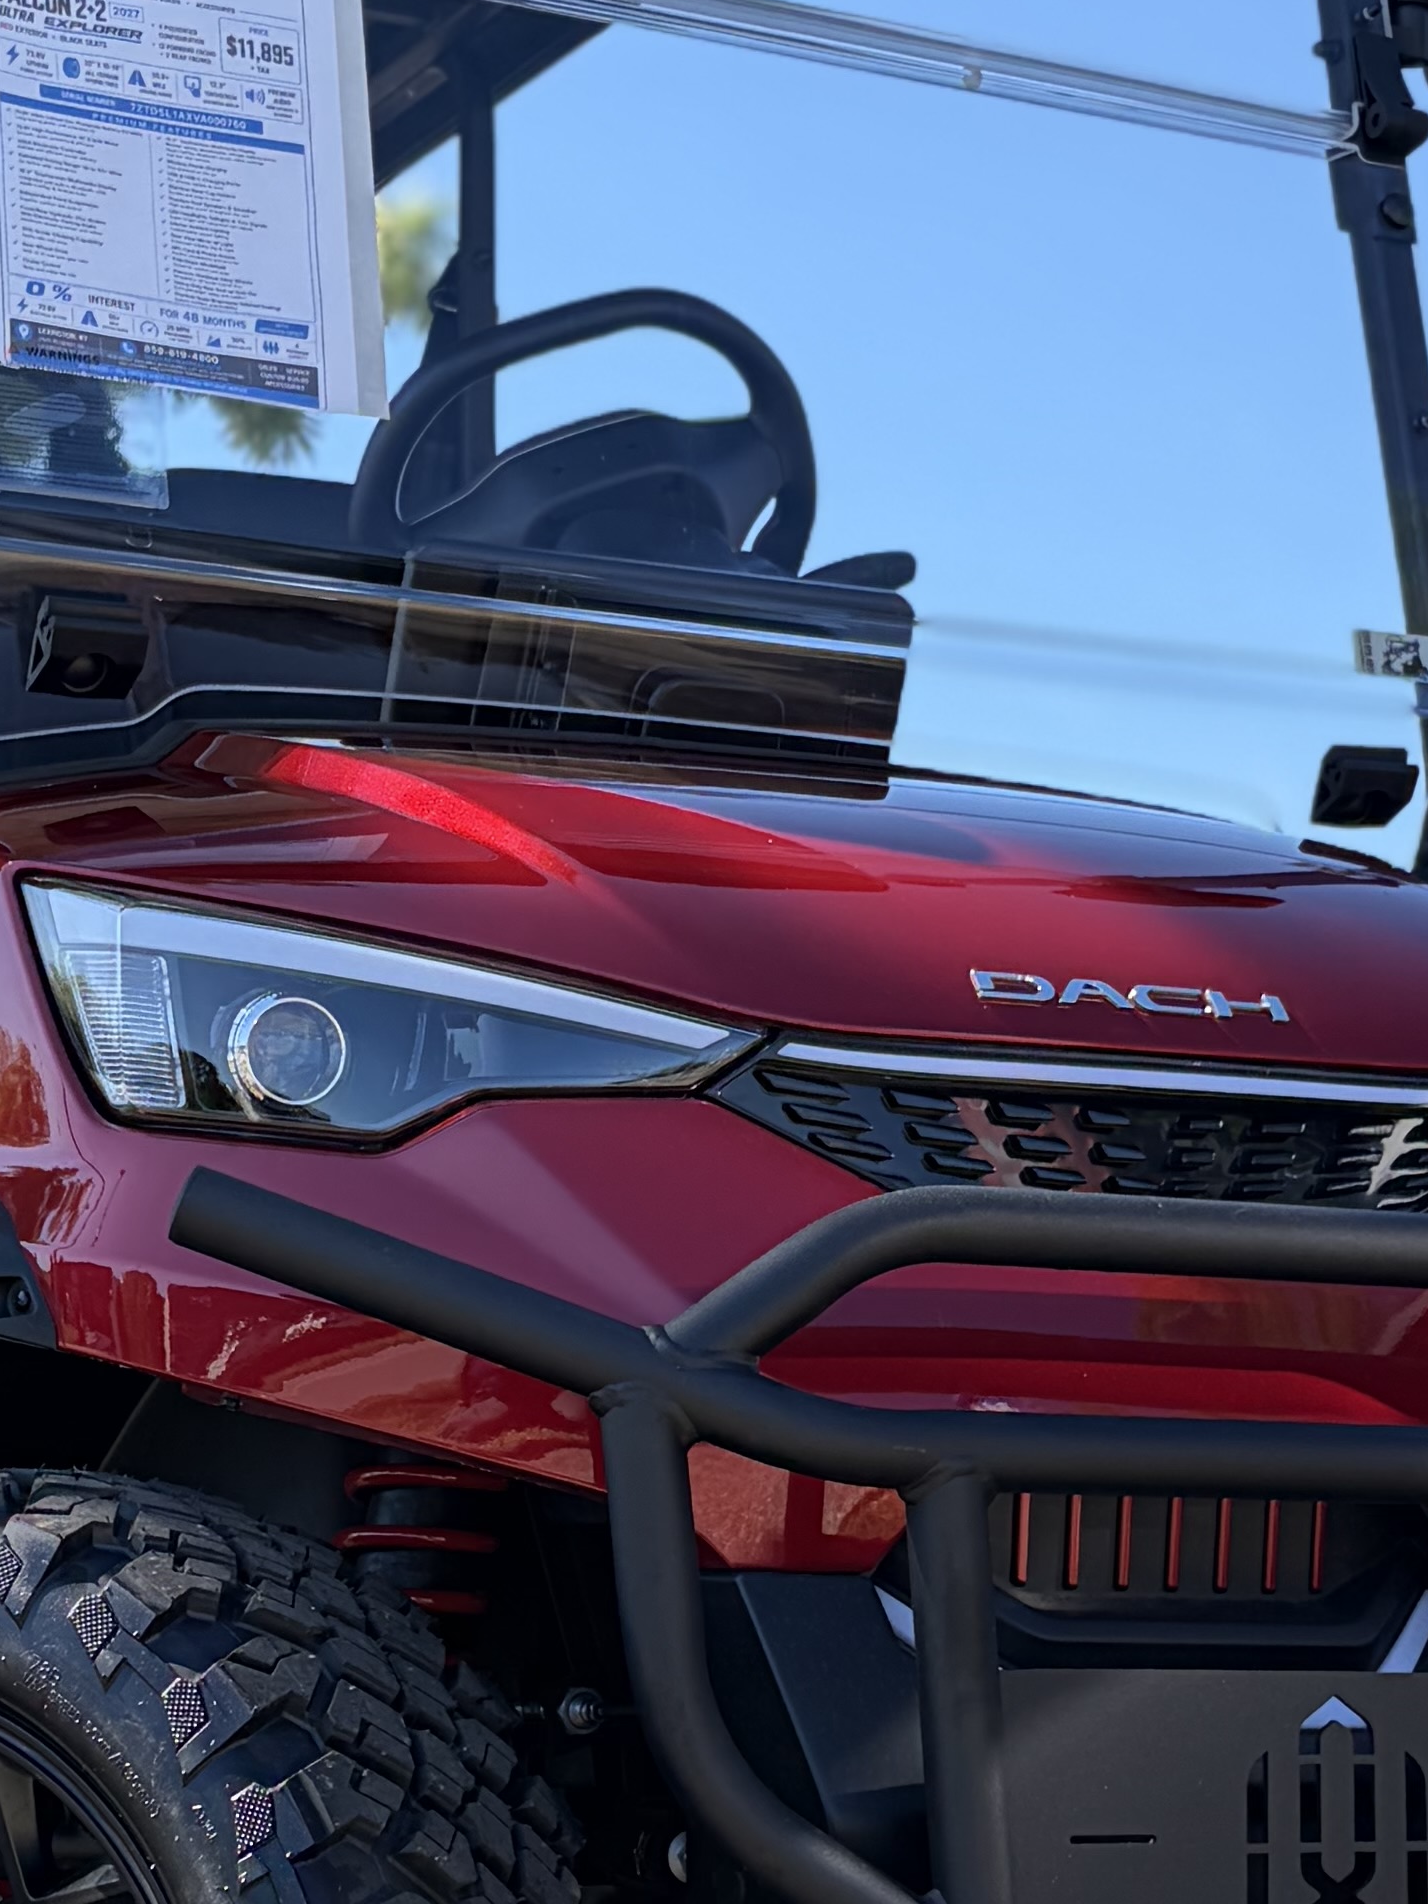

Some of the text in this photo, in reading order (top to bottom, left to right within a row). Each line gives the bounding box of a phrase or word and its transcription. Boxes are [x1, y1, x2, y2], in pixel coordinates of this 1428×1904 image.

[44, 16, 143, 40] EXPLORER
[226, 34, 294, 67] $11,895
[88, 294, 136, 312] INTEREST
[160, 307, 179, 320] FOR
[202, 315, 247, 330] MONTHS
[26, 346, 100, 366] WARNINGS
[970, 968, 1290, 1023] DACH
